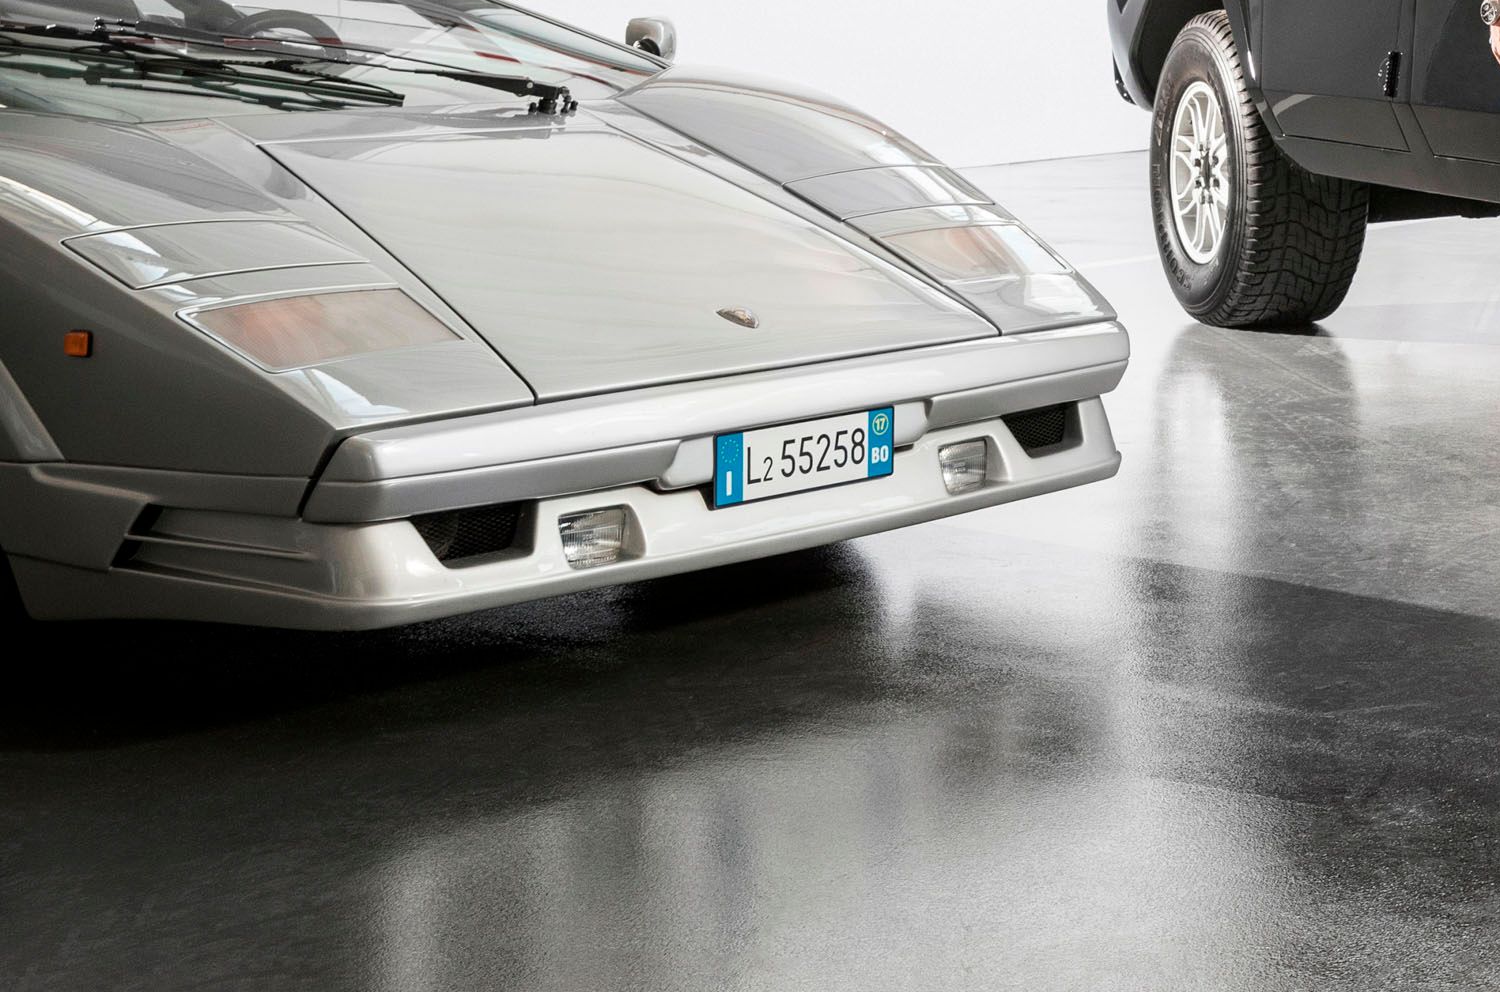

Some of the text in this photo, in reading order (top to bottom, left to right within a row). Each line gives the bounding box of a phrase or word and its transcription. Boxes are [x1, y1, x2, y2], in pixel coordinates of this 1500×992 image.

[874, 417, 886, 431] 17
[781, 428, 865, 477] 55258
[871, 445, 890, 464] BO
